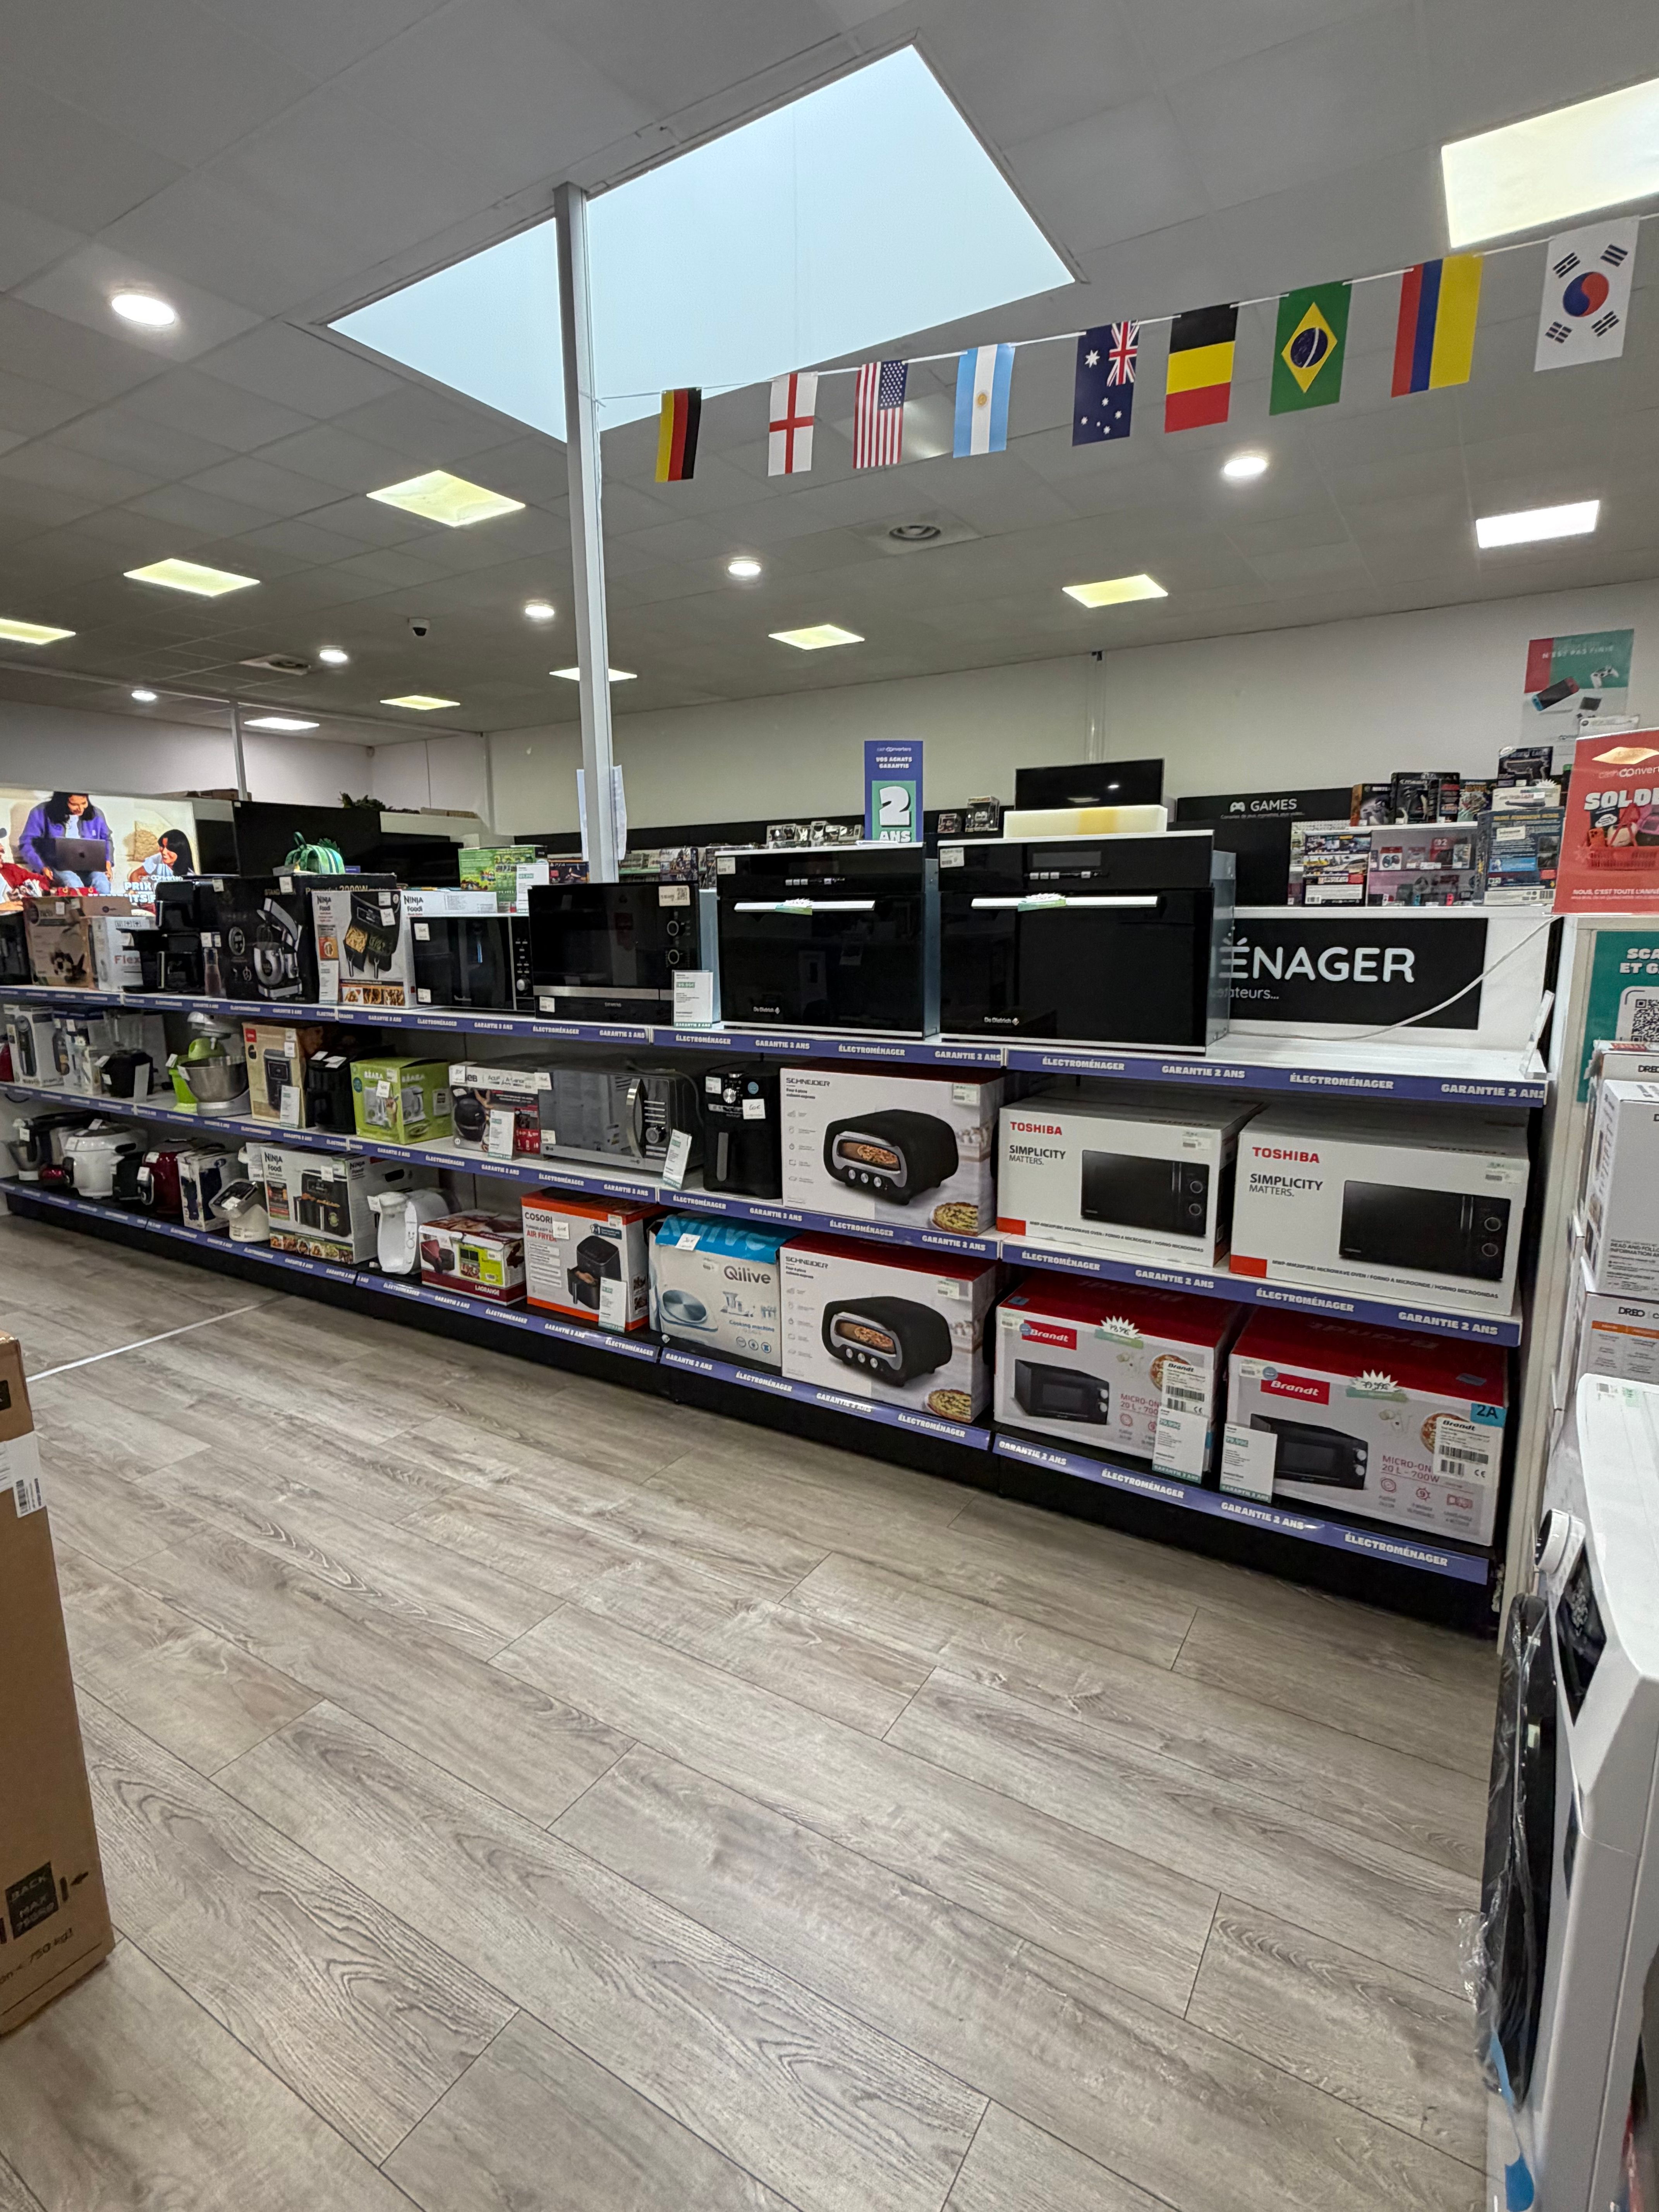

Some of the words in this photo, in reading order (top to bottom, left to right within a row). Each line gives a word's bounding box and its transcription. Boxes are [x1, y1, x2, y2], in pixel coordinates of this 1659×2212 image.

[879, 786, 911, 828] 2
[1250, 799, 1297, 812] GAMES
[879, 831, 911, 843] ANS
[124, 881, 152, 891] PRIX
[317, 895, 332, 905] NINJA
[404, 895, 424, 906] NINJA
[1619, 962, 1643, 974] ET
[532, 1025, 579, 1034] ÉLECTROMÉNAGER
[676, 1034, 731, 1044] ÉLECTROMÉNAGER
[755, 1040, 788, 1048] GARANTIE
[838, 1044, 905, 1056] ÉLECTROMÉNAGER
[935, 1051, 975, 1060] GARANTIE
[984, 1053, 1001, 1061] ANS
[1042, 1056, 1125, 1070] ÉLECTROMÉNAGER
[1162, 1065, 1212, 1076] GARANTIE
[1223, 1070, 1245, 1078] ANS
[786, 1077, 830, 1087] SCHNEIDER
[1290, 1072, 1394, 1089] ÉLECTROMÉNAGER
[1441, 1084, 1506, 1096] GARANTIE
[1508, 1088, 1516, 1097] 2
[1519, 1089, 1544, 1098] ANS
[1010, 1121, 1063, 1135] TOSHIBA
[264, 1152, 283, 1165] NINJA
[1009, 1145, 1066, 1160] SIMPLICITY
[1252, 1147, 1320, 1163] TOSHIBA
[1009, 1154, 1044, 1166] MATTERS.
[539, 1173, 584, 1186] ÉLECTROMÉNAGER
[1250, 1173, 1323, 1191] SIMPLICITY
[604, 1184, 631, 1193] GARANTIE
[1249, 1184, 1294, 1197] MATTERS.
[673, 1194, 726, 1209] ÉLECTROMÉNAGER
[525, 1212, 553, 1224] COSORI
[750, 1207, 781, 1218] GARANTIE
[527, 1230, 537, 1238] AIR
[830, 1219, 894, 1237] ÉLECTROMÉNAGER
[922, 1235, 961, 1247] GARANTIE
[969, 1242, 986, 1251] ANS
[1610, 1248, 1652, 1257] INFORMATION
[785, 1256, 828, 1269] SCHNEIDER
[1022, 1251, 1100, 1271] ÉLECTROMÉNAGER
[723, 1266, 771, 1284] Qilive
[1135, 1269, 1183, 1284] GARANTIE
[1194, 1279, 1214, 1288] ANS
[1317, 1267, 1350, 1276] MICROWAVE
[1457, 1288, 1498, 1298] MICROONDAS
[1256, 1288, 1354, 1312] ÉLECTROMÉNAGER
[1618, 1306, 1645, 1317] DREO
[729, 1319, 751, 1329] Cooking
[1398, 1312, 1459, 1329] GARANTIE
[1461, 1322, 1469, 1331] 2
[1472, 1324, 1498, 1335] ANS
[1030, 1329, 1069, 1343] Brandt
[605, 1338, 653, 1357] ÉLECTROMÉNAGER
[666, 1353, 695, 1366] GARANTIE
[1168, 1363, 1194, 1372] Brandt
[736, 1371, 792, 1392] ÉLECTROMÉNAGER
[1271, 1380, 1319, 1397] Brandt
[816, 1393, 850, 1407] GARANTIE
[857, 1402, 872, 1413] ANS
[1144, 1406, 1159, 1415] 700
[1477, 1404, 1498, 1419] 2A
[897, 1413, 966, 1438] ÉLECTROMÉNAGER
[1443, 1420, 1476, 1431] Brandt
[999, 1441, 1040, 1458] GARANTIE
[1049, 1454, 1066, 1465] ANS
[1382, 1455, 1432, 1473] MICRO-ON
[1382, 1464, 1394, 1472] 20
[1412, 1470, 1440, 1483] 700W
[1102, 1468, 1184, 1496] ÉLECTROMÉNAGER
[1221, 1502, 1272, 1522] GARANTIE
[1273, 1516, 1280, 1524] 2
[1283, 1517, 1304, 1530] ANS
[1345, 1532, 1448, 1566] ÉLECTROMÉNAGER
